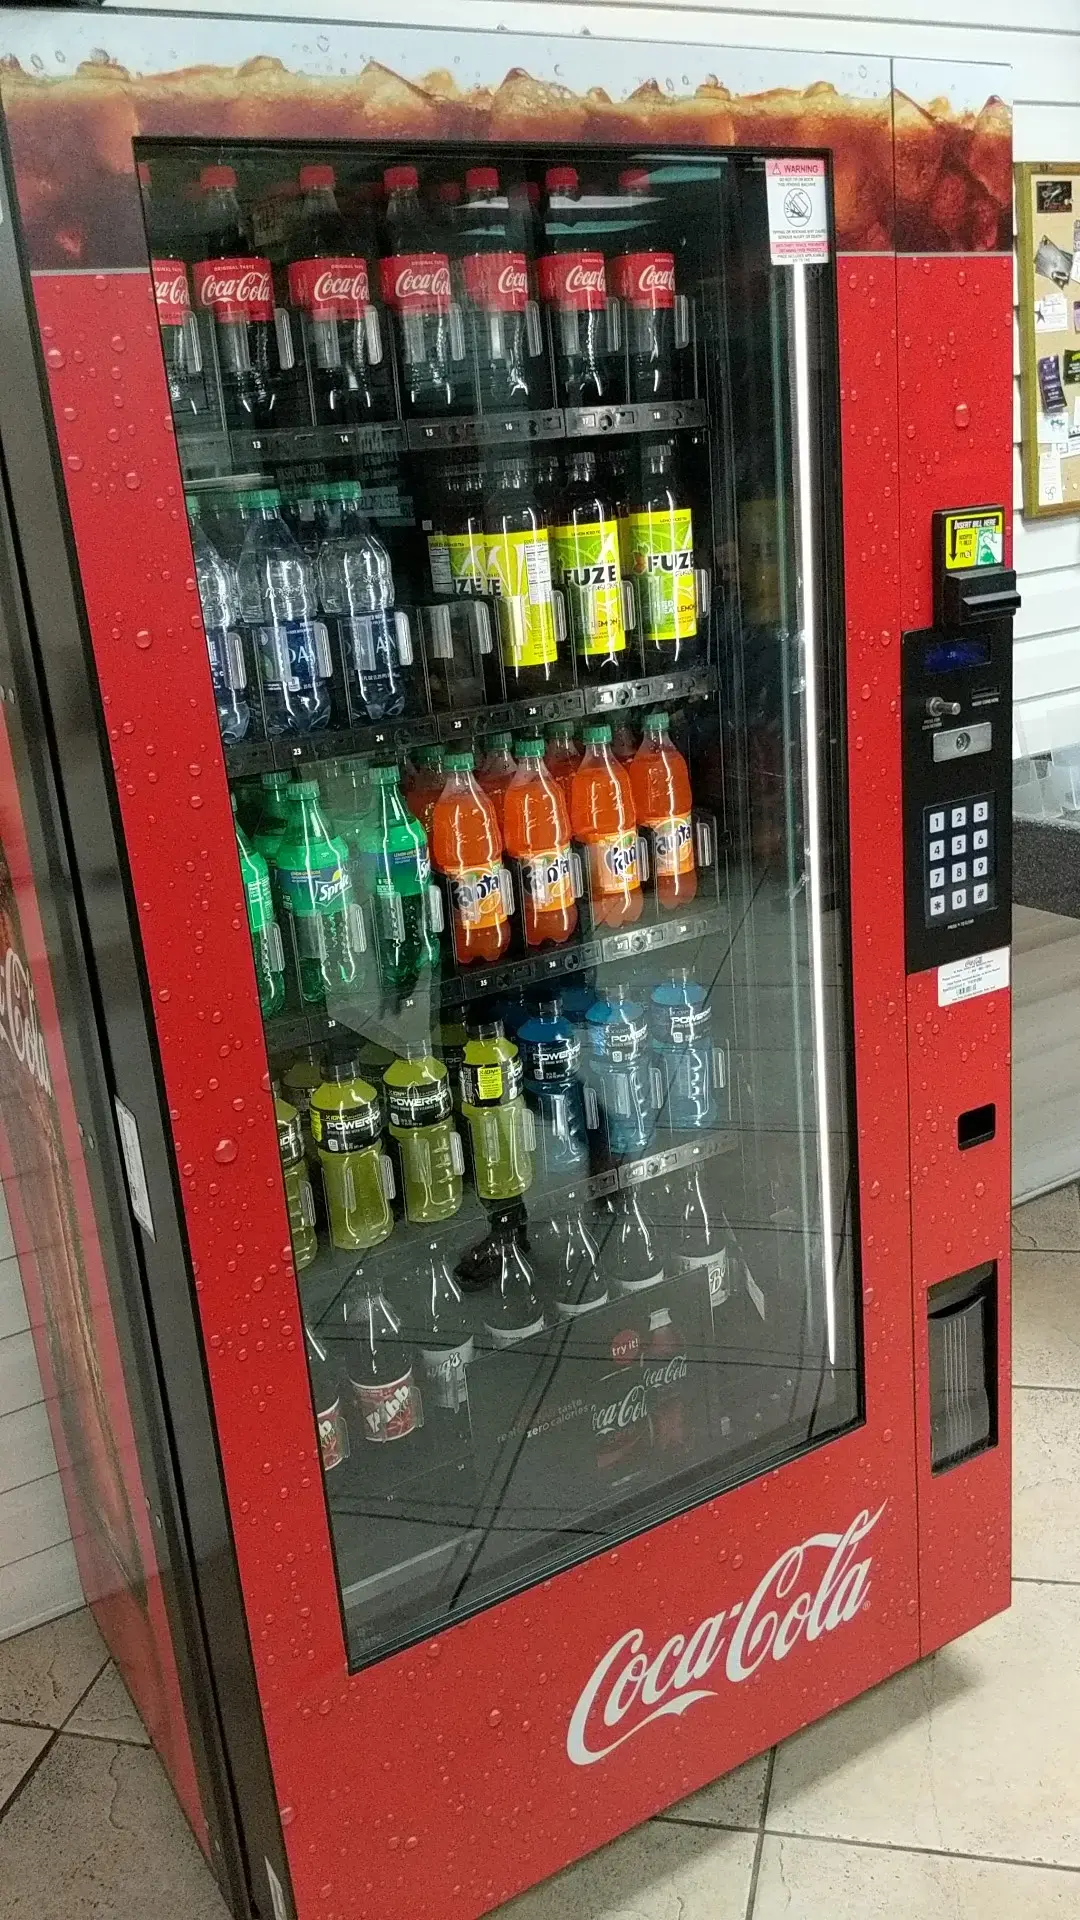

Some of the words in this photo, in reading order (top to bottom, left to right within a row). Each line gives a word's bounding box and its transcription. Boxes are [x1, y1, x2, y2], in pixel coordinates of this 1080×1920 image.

[784, 164, 819, 174] WARNING
[201, 271, 270, 305] Coca-Cola
[653, 411, 661, 419] 18
[582, 417, 590, 425] 17
[425, 428, 434, 437] 15
[340, 435, 349, 443] 14
[252, 441, 261, 449] 13
[954, 520, 972, 530] INSERT
[972, 520, 982, 528] BILL
[983, 518, 997, 526] HERE
[563, 564, 616, 587] FUZE
[677, 603, 697, 613] LEMON
[529, 707, 537, 715] 26
[935, 818, 939, 827] 1
[956, 812, 962, 822] 2
[978, 807, 984, 817] 3
[934, 845, 940, 855] 4
[956, 840, 962, 850] 5
[978, 835, 984, 845] 6
[934, 873, 940, 883] 7
[956, 867, 962, 877] 8
[978, 862, 984, 872] 9
[956, 894, 962, 904] 0
[405, 999, 414, 1007] 34
[355, 1268, 364, 1276] 43
[612, 1344, 628, 1357] try
[628, 1338, 640, 1349] it!
[526, 1422, 550, 1439] zero
[550, 1404, 589, 1428] calories
[567, 1497, 889, 1766] Coca-Cola
